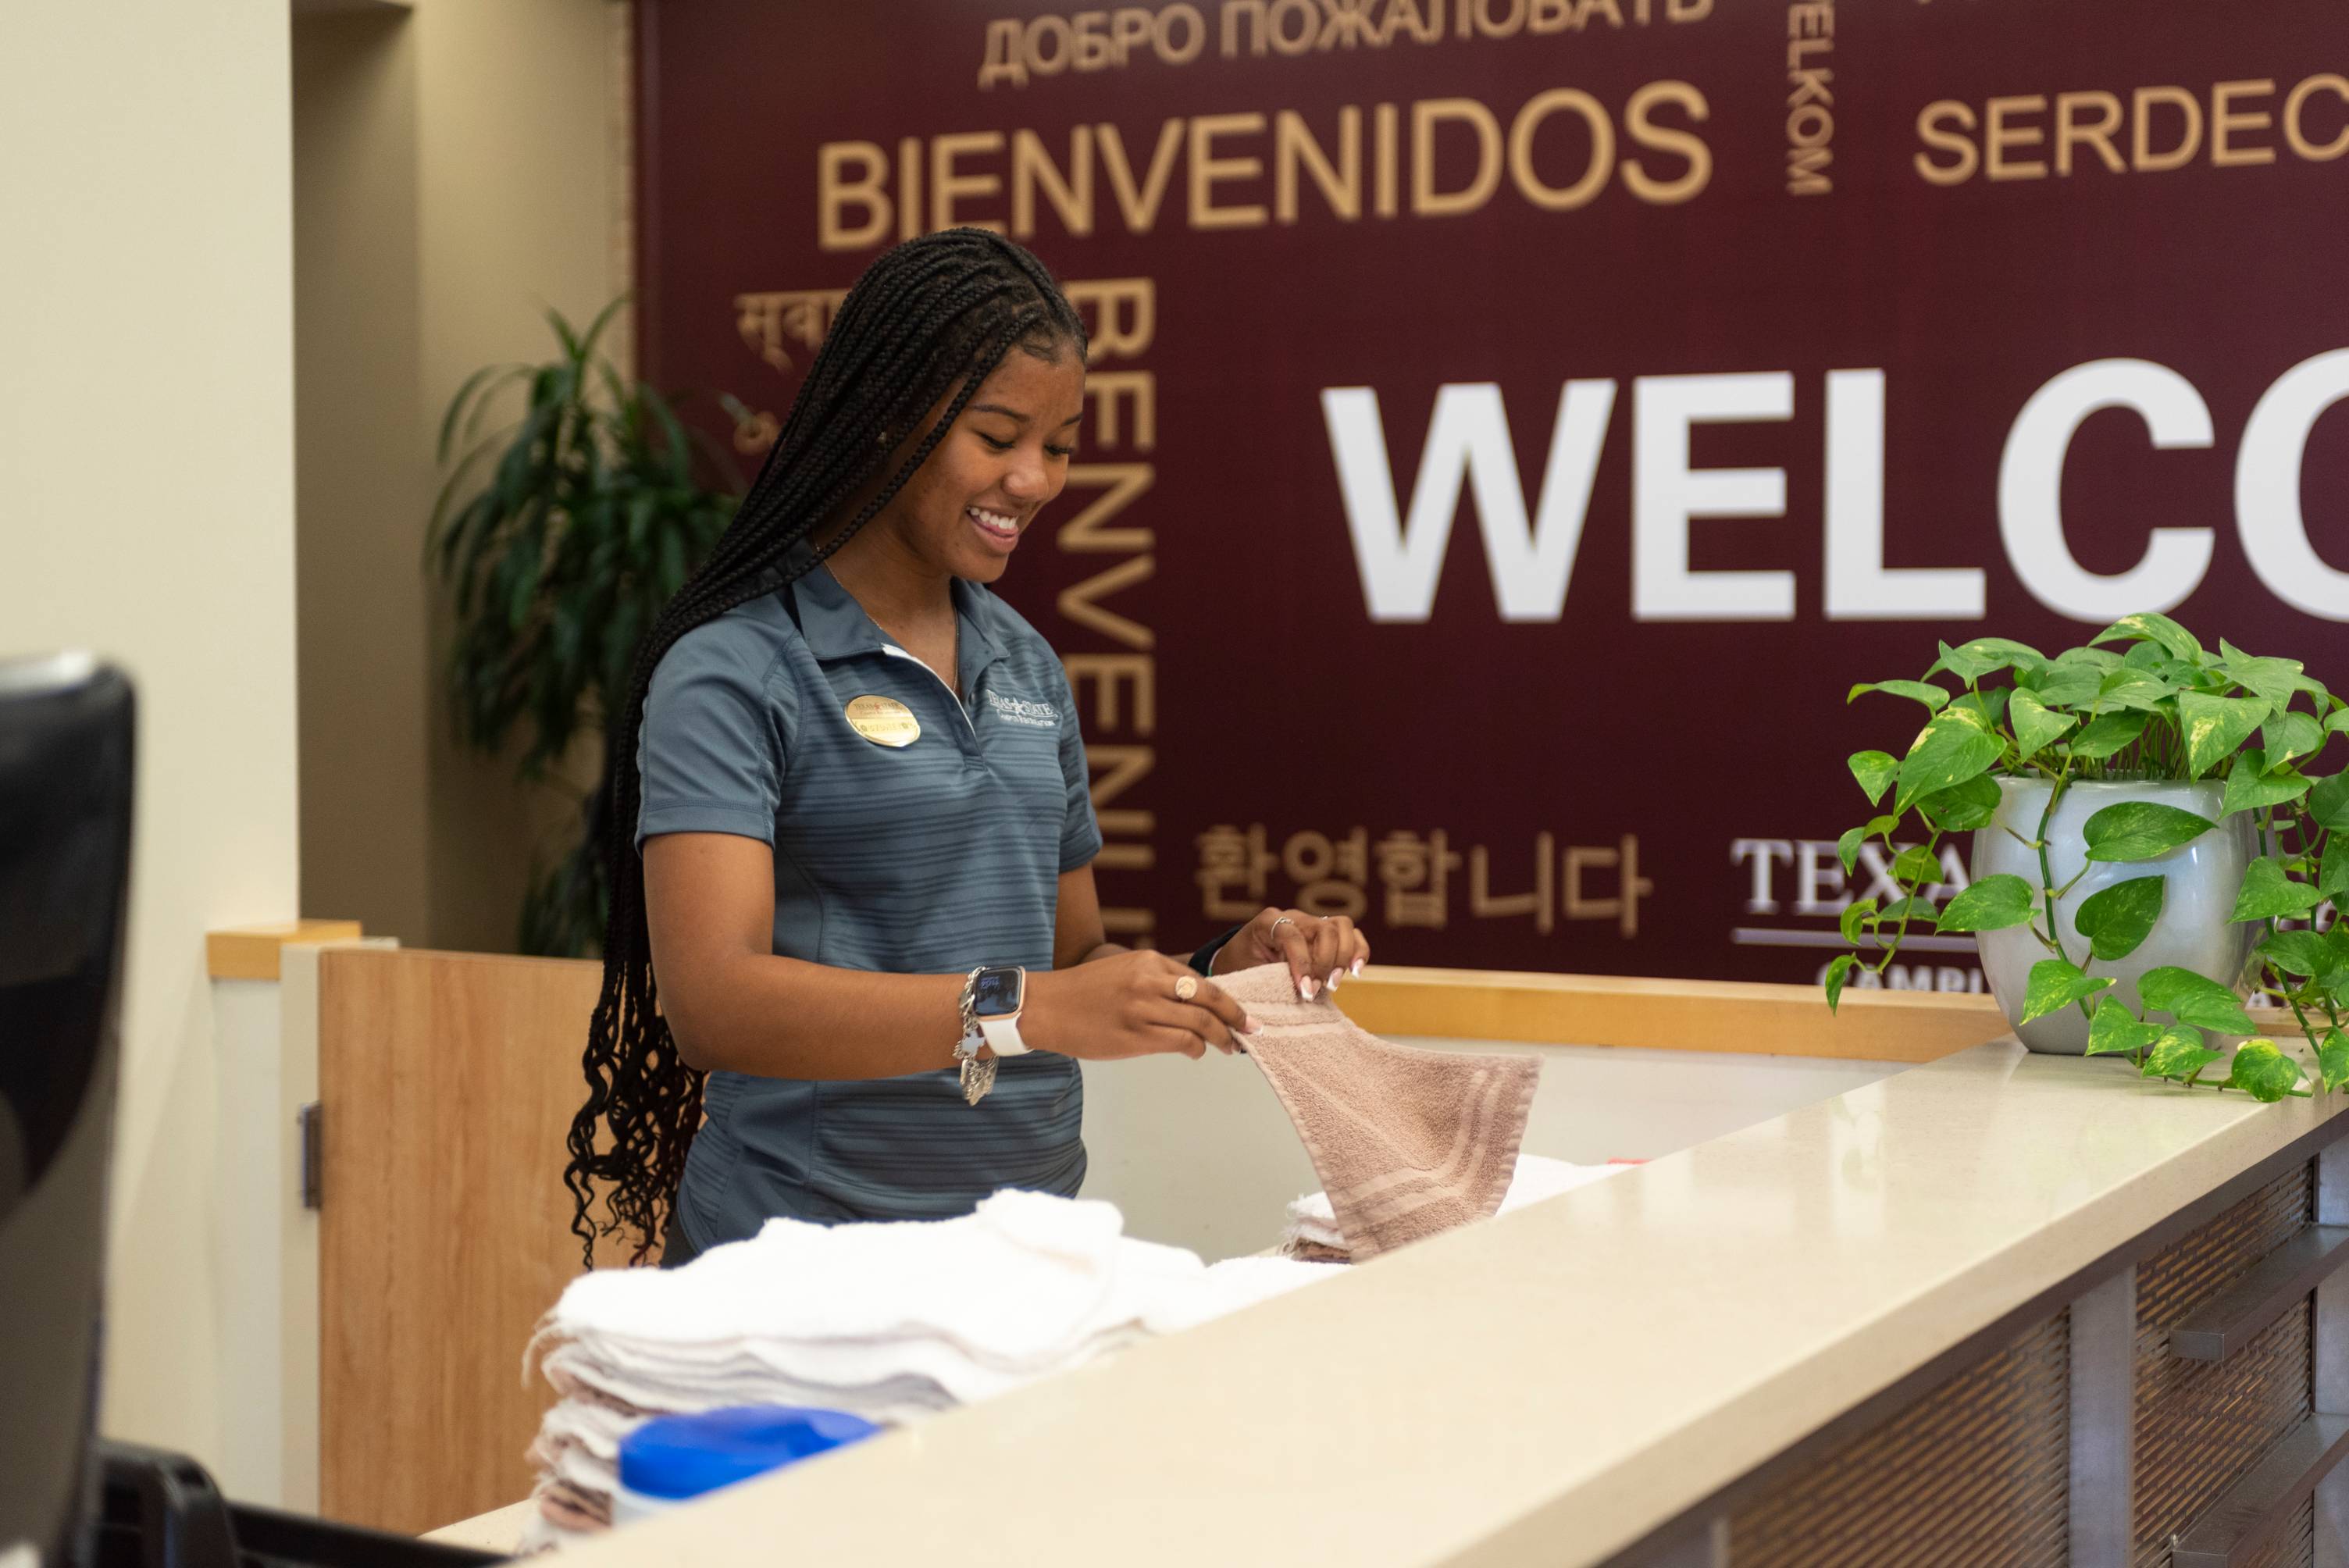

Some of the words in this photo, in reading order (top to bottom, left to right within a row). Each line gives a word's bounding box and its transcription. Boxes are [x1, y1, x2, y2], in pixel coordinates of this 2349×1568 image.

[978, 3, 1207, 89] ДОБРО
[1786, 0, 1834, 195] ELKOM
[817, 79, 1714, 253] BIENVENIDOS
[1914, 73, 2349, 187] SERDEC
[1057, 277, 1156, 950] BENVENU
[1196, 822, 1654, 939] 환영합니다
[1730, 837, 1971, 917] TEXA
